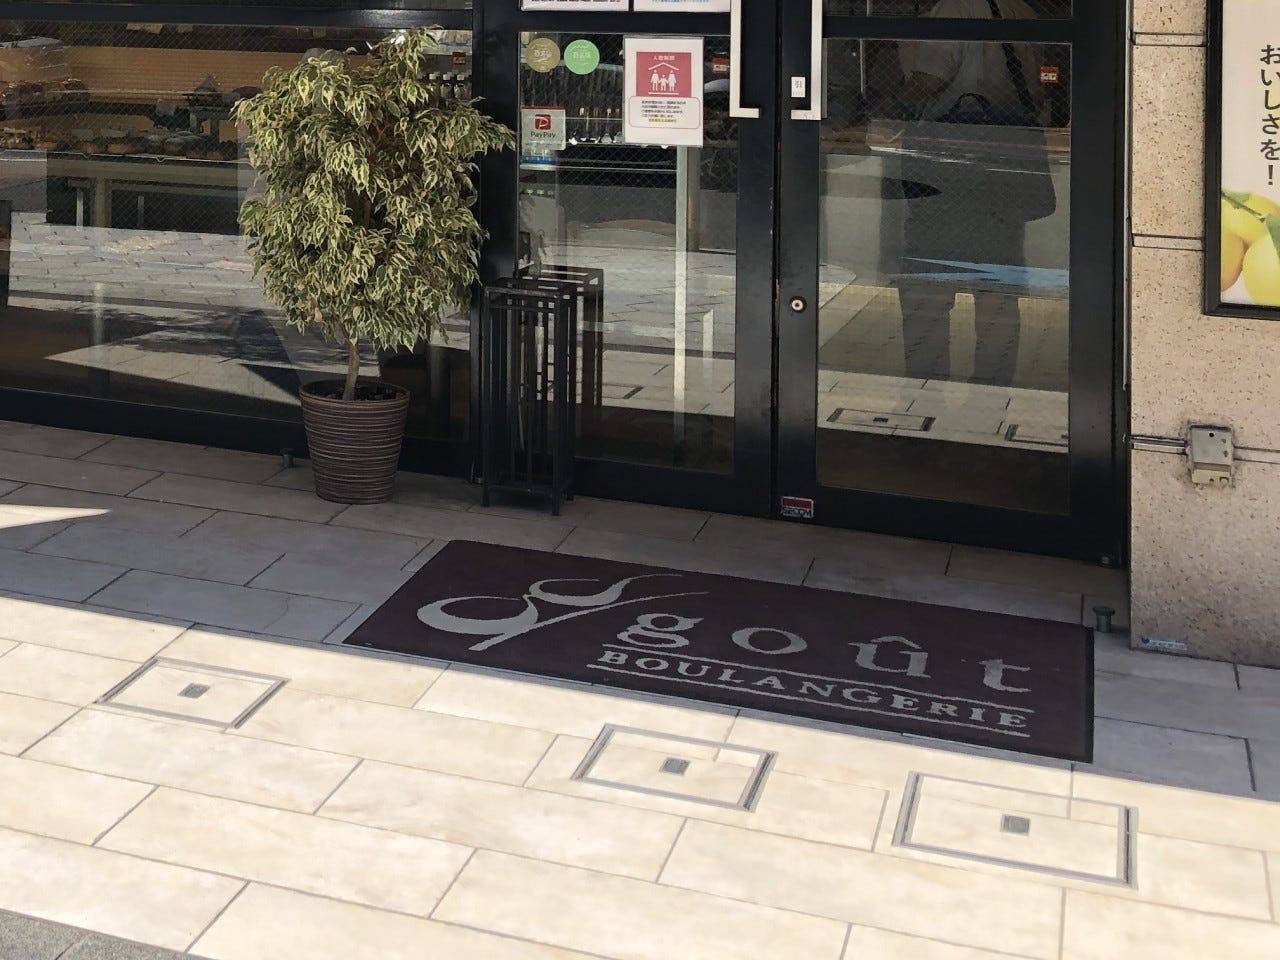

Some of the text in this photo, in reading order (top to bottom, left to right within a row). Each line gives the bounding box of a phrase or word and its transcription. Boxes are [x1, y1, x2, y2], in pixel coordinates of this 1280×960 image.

[530, 131, 557, 139] PayPay
[597, 650, 1030, 729] BOULANGERIE
[615, 612, 1032, 693] goût
